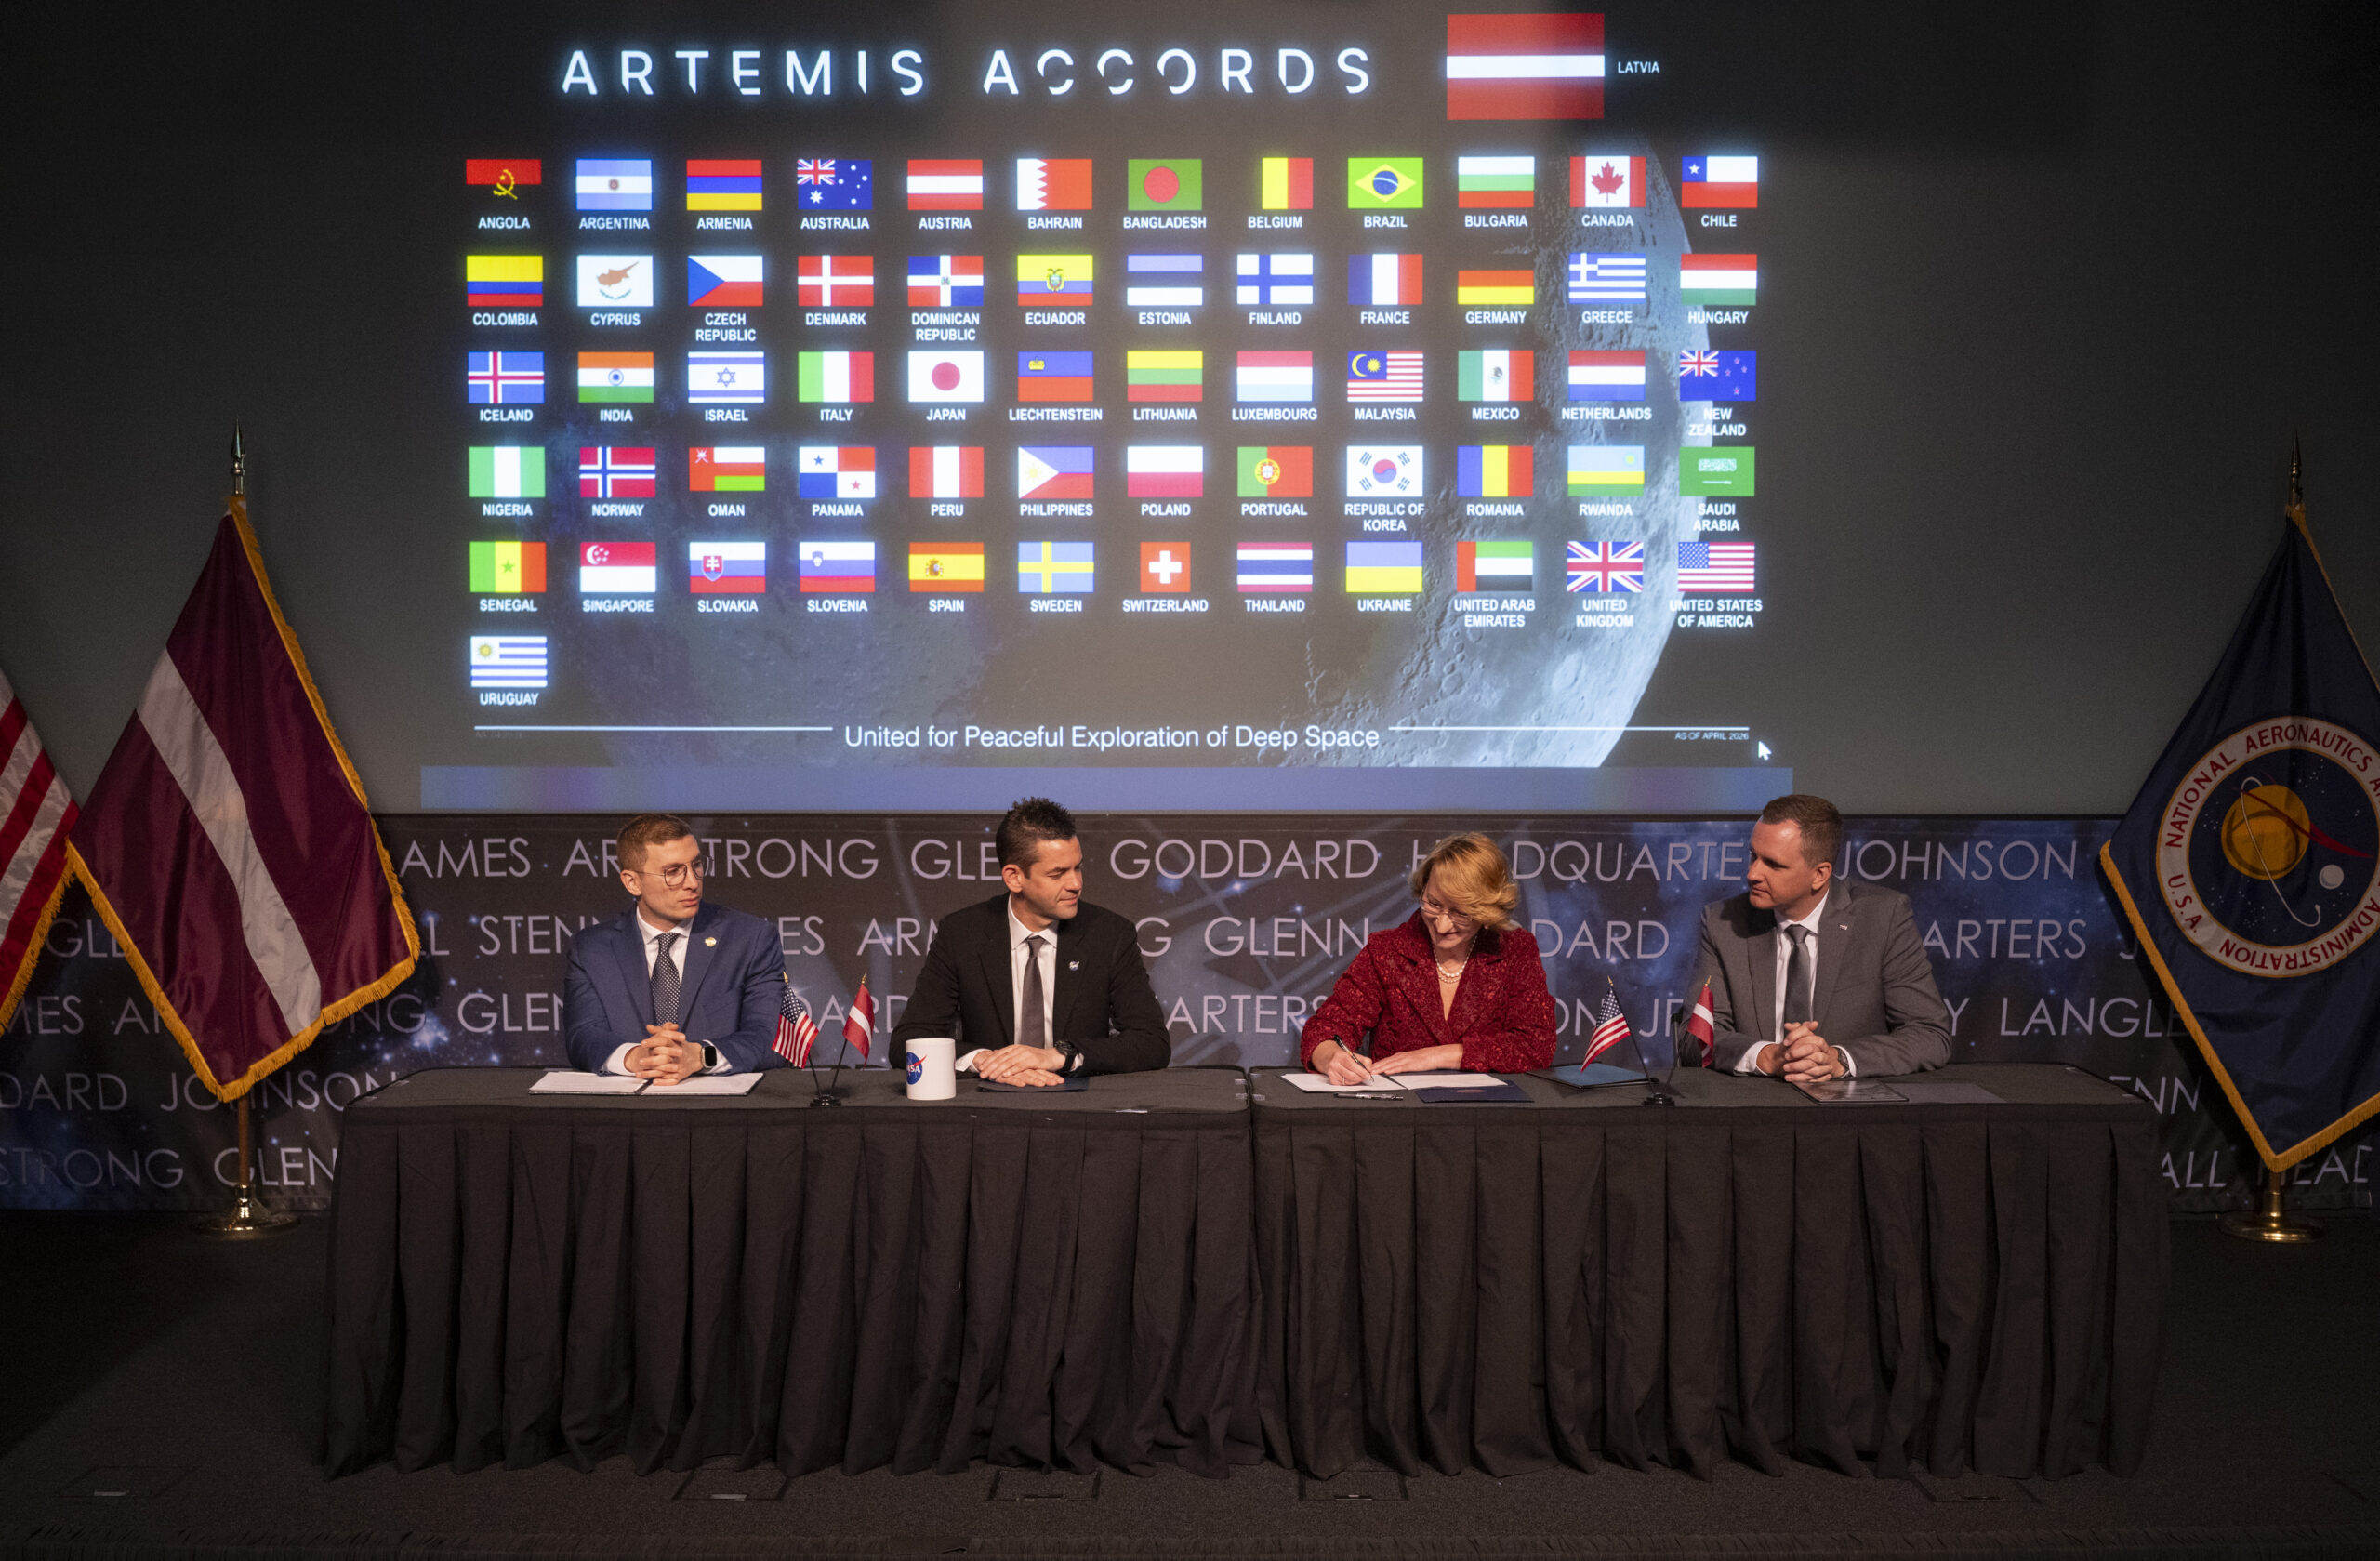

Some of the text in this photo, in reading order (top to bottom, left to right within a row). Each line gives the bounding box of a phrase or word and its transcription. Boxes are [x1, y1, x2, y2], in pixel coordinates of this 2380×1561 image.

[562, 48, 1368, 95] ARTEMIS ACCORDS
[1619, 62, 1659, 73] LATVIA
[479, 217, 530, 229] ANGOLA
[579, 218, 650, 229] ARGENTINA
[697, 218, 752, 229] ARMENIA
[801, 218, 869, 229] AUSTRALIA
[919, 218, 972, 229] AUSTRIA
[1028, 218, 1082, 229] BAHRAIN
[1124, 217, 1206, 229] BANGLADESH
[1249, 217, 1302, 228] BELGIUM
[1365, 216, 1407, 227] BRAZIL
[1465, 216, 1527, 227] BULGARIA
[1582, 215, 1633, 226] CANADA
[1701, 215, 1737, 227] CHILE
[473, 313, 537, 325] COLOMBIA
[591, 313, 640, 325] CYPRUS
[706, 313, 746, 325] CZECH
[806, 313, 866, 324] DENMARK
[912, 313, 979, 324] DOMINICAN
[1026, 312, 1085, 324] ECUADOR
[1139, 312, 1191, 324] ESTONIA
[1250, 312, 1301, 324] FINLAND
[1361, 311, 1409, 324] FRANCE
[1466, 311, 1526, 324] GERMANY
[1582, 311, 1632, 323] GREECE
[1688, 311, 1748, 324] HUNGARY
[696, 329, 756, 341] REPUBLIC
[916, 329, 975, 340] REPUBLIC
[481, 409, 533, 421] ICELAND
[601, 410, 632, 421] INDIA
[706, 409, 748, 421] ISRAEL
[821, 409, 853, 420] ITALY
[927, 409, 965, 420] JAPAN
[1010, 408, 1102, 420] LIECHTENSTEIN
[1134, 409, 1197, 420] LITHUANIA
[1233, 408, 1316, 420] LUXEMBOURG
[1355, 408, 1416, 419] MALAYSIA
[1473, 408, 1519, 419] MEXICO
[1562, 407, 1651, 420] NETHERLANDS
[1704, 408, 1732, 420] NEW
[1688, 423, 1746, 436] ZEALAND
[483, 504, 533, 516] NIGERIA
[592, 504, 643, 516] NORWAY
[709, 505, 745, 516] OMAN
[813, 505, 863, 515] PANAMA
[932, 504, 963, 516] PERU
[1021, 504, 1092, 516] PHILIPPINES
[1142, 504, 1190, 516] POLAND
[1242, 504, 1307, 515] PORTUGAL
[1345, 503, 1424, 515] REPUBLIC OF
[1467, 504, 1524, 516] ROMANIA
[1580, 504, 1633, 516] RWANDA
[1698, 504, 1735, 516] SAUDI
[1364, 520, 1406, 531] KOREA
[1694, 520, 1739, 532] ARABIA
[480, 599, 536, 611] SENEGAL
[583, 600, 654, 612] SINGAPORE
[698, 600, 758, 612] SLOVAKIA
[808, 600, 867, 612] SLOVENIA
[930, 600, 964, 612] SPAIN
[1031, 600, 1081, 612] SWEDEN
[1123, 600, 1208, 612] SWITZERLAND
[1245, 600, 1304, 611] THAILAND
[1358, 599, 1411, 611] UKRAINE
[1455, 599, 1535, 611] UNITED ARAB
[1583, 599, 1627, 611] UNITED
[1670, 599, 1762, 611] UNITED STATES
[1465, 615, 1525, 627] EMIRATES
[1577, 615, 1633, 628] KINGDOM
[1678, 615, 1753, 627] OF AMERICA
[481, 693, 538, 705] URUGUAY
[846, 725, 1379, 751] United for Peaceful Exploration of Deep Space
[1675, 732, 1749, 740] AS OF APRIL 2026
[2165, 723, 2372, 848] NATIONAL AERONAUTICS
[400, 838, 532, 879] AMES
[562, 838, 879, 879] ARTRONG
[910, 839, 1002, 880] GLE
[1109, 839, 1379, 880] GODDARD
[1836, 840, 2078, 880] JOHNSON
[1204, 917, 1368, 957] GLENN
[1532, 919, 1670, 959] DARD
[2219, 897, 2380, 970] ADMINISTRATION
